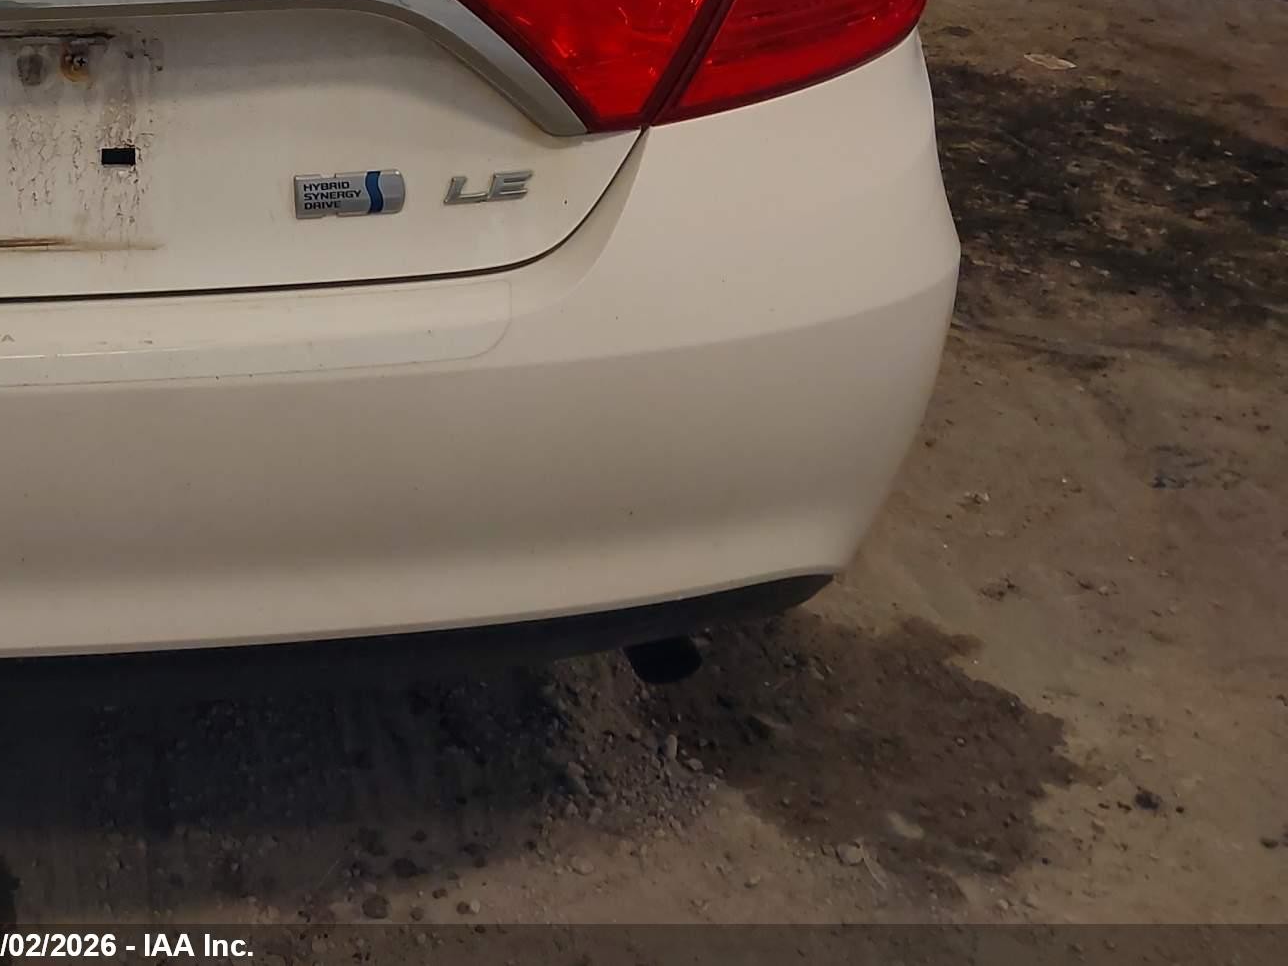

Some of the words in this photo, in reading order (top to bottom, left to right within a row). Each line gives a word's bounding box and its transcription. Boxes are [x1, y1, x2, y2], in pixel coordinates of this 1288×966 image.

[303, 181, 350, 191] HYBRID
[443, 170, 533, 206] LE
[303, 189, 362, 201] SYNERGY
[304, 200, 341, 210] DRIVE
